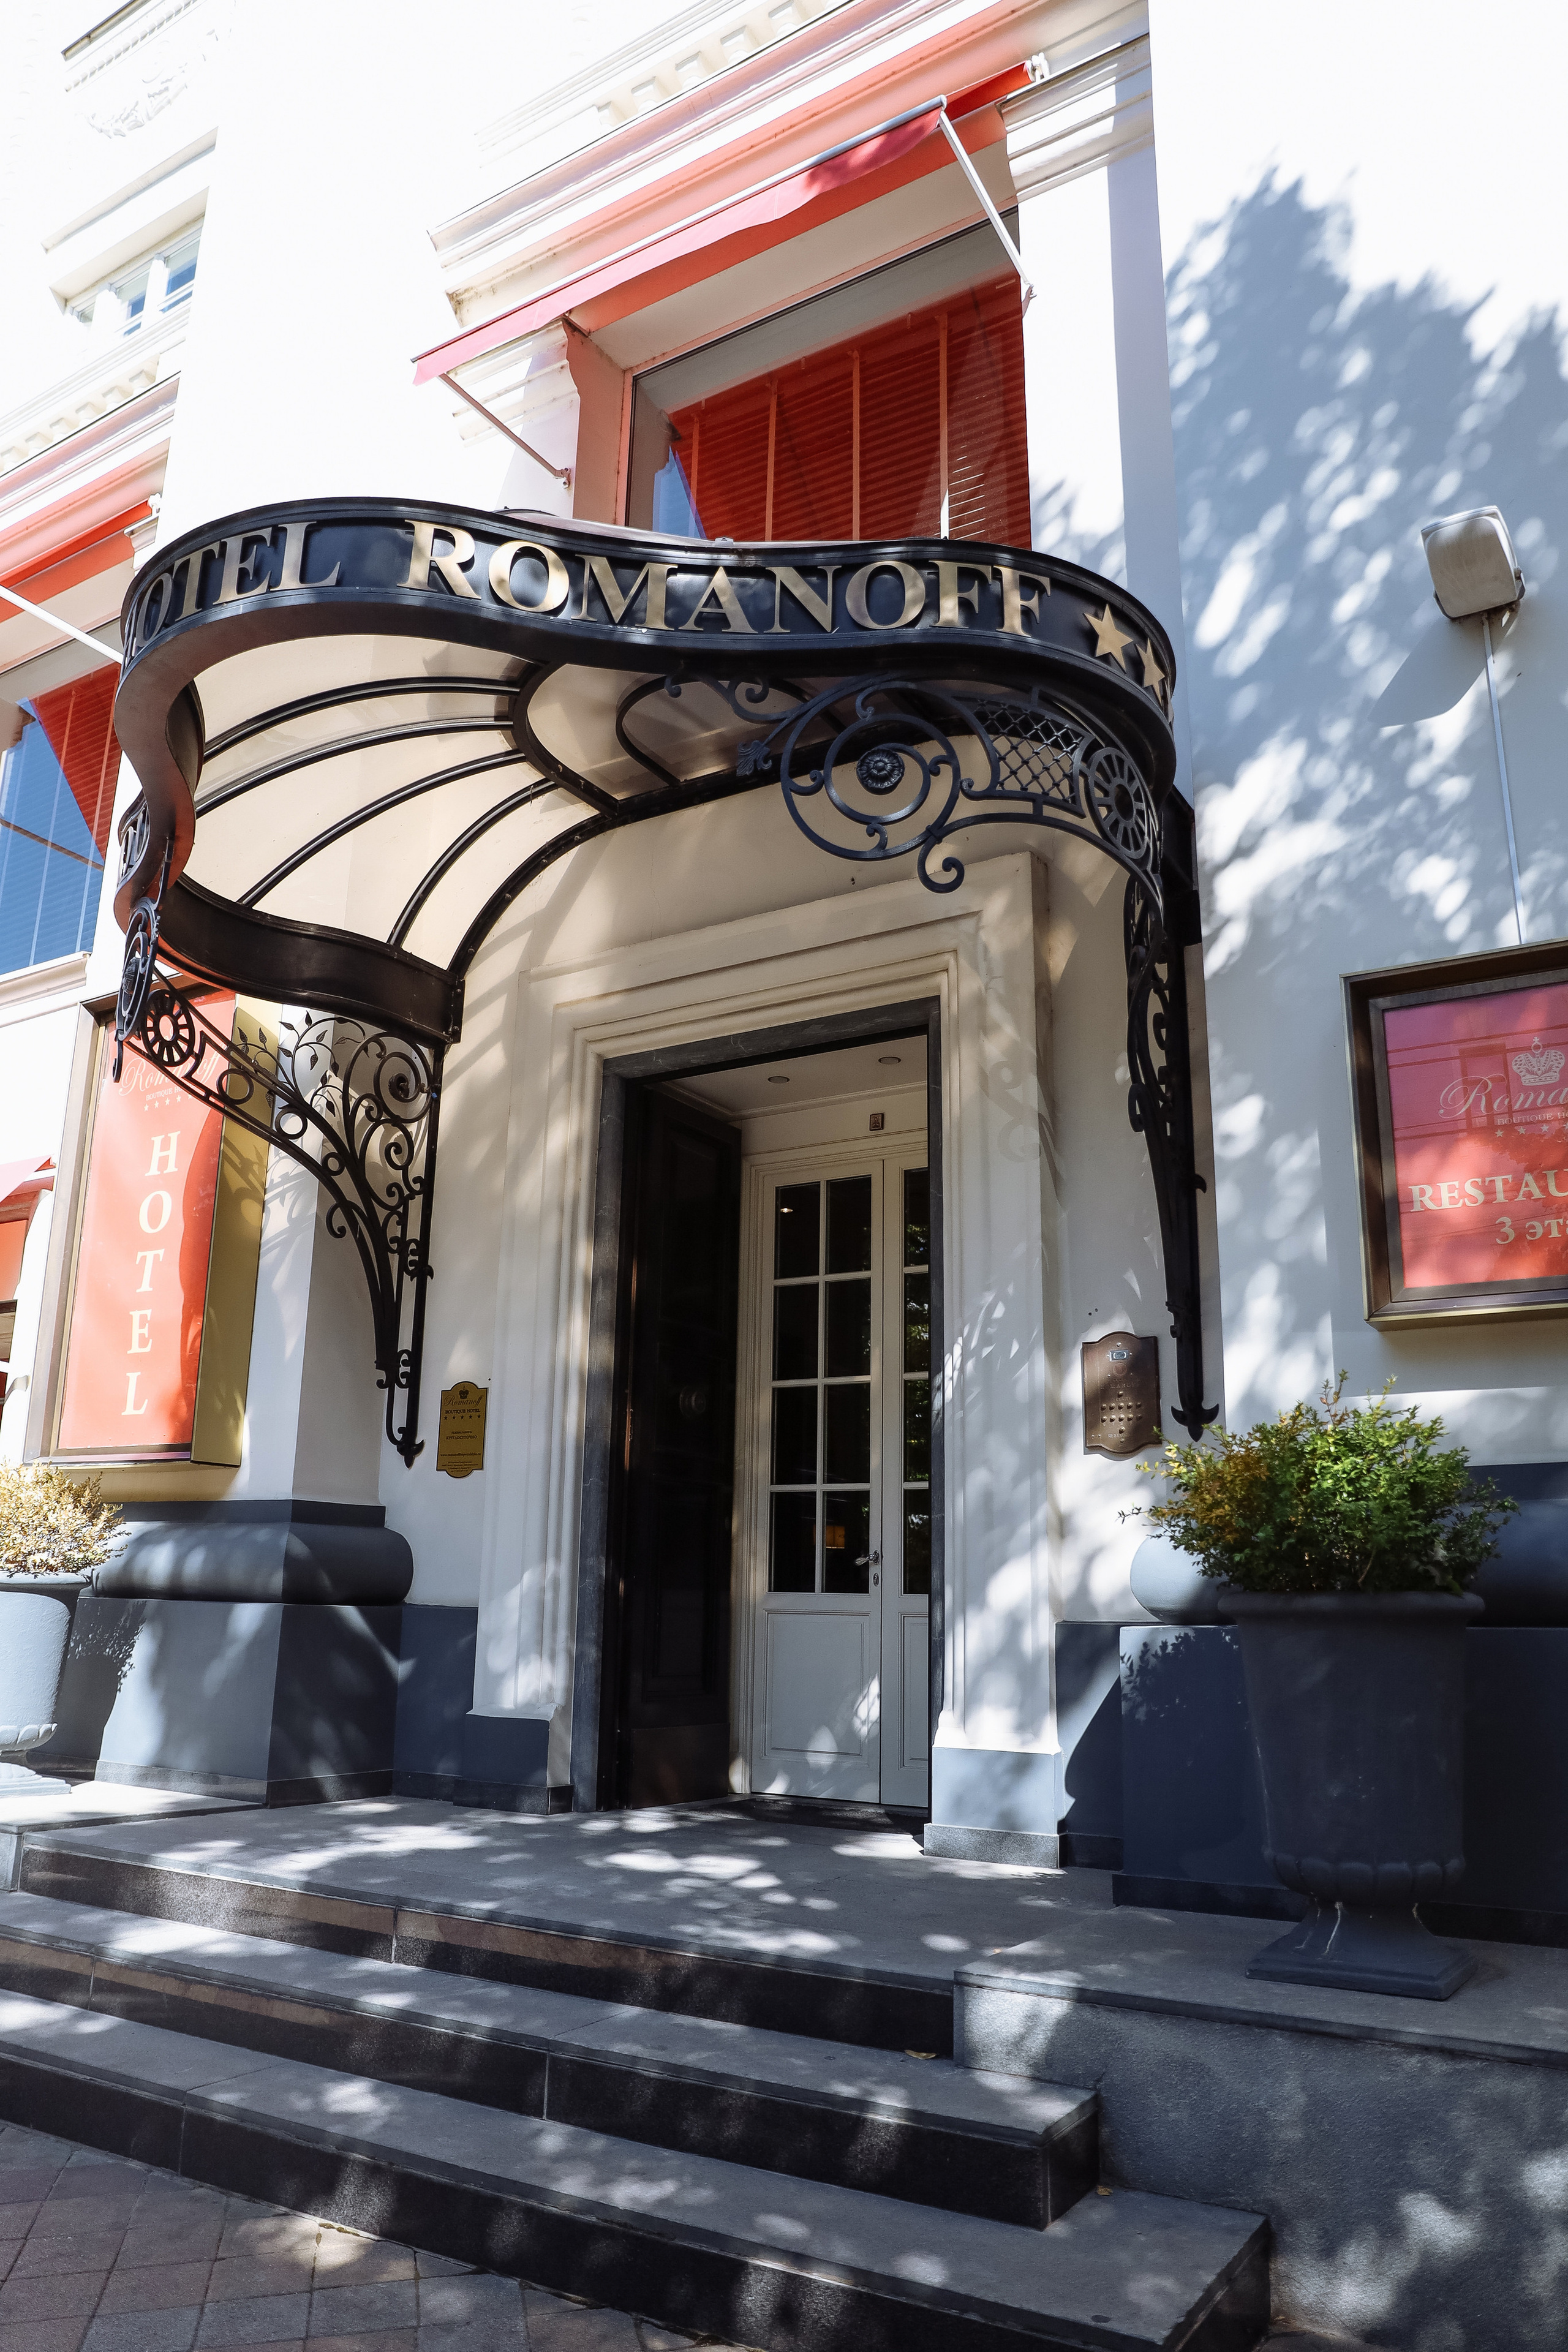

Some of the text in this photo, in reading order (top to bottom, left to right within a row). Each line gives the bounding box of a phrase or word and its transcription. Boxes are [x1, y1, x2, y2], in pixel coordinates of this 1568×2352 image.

[127, 519, 1051, 662] OTEL ROMANOFF
[146, 1088, 173, 1101] BOUTIQUE
[1498, 1112, 1555, 1126] BOUTIQUE
[1495, 1216, 1568, 1245] 3 эт
[121, 1131, 180, 1416] HOTEL
